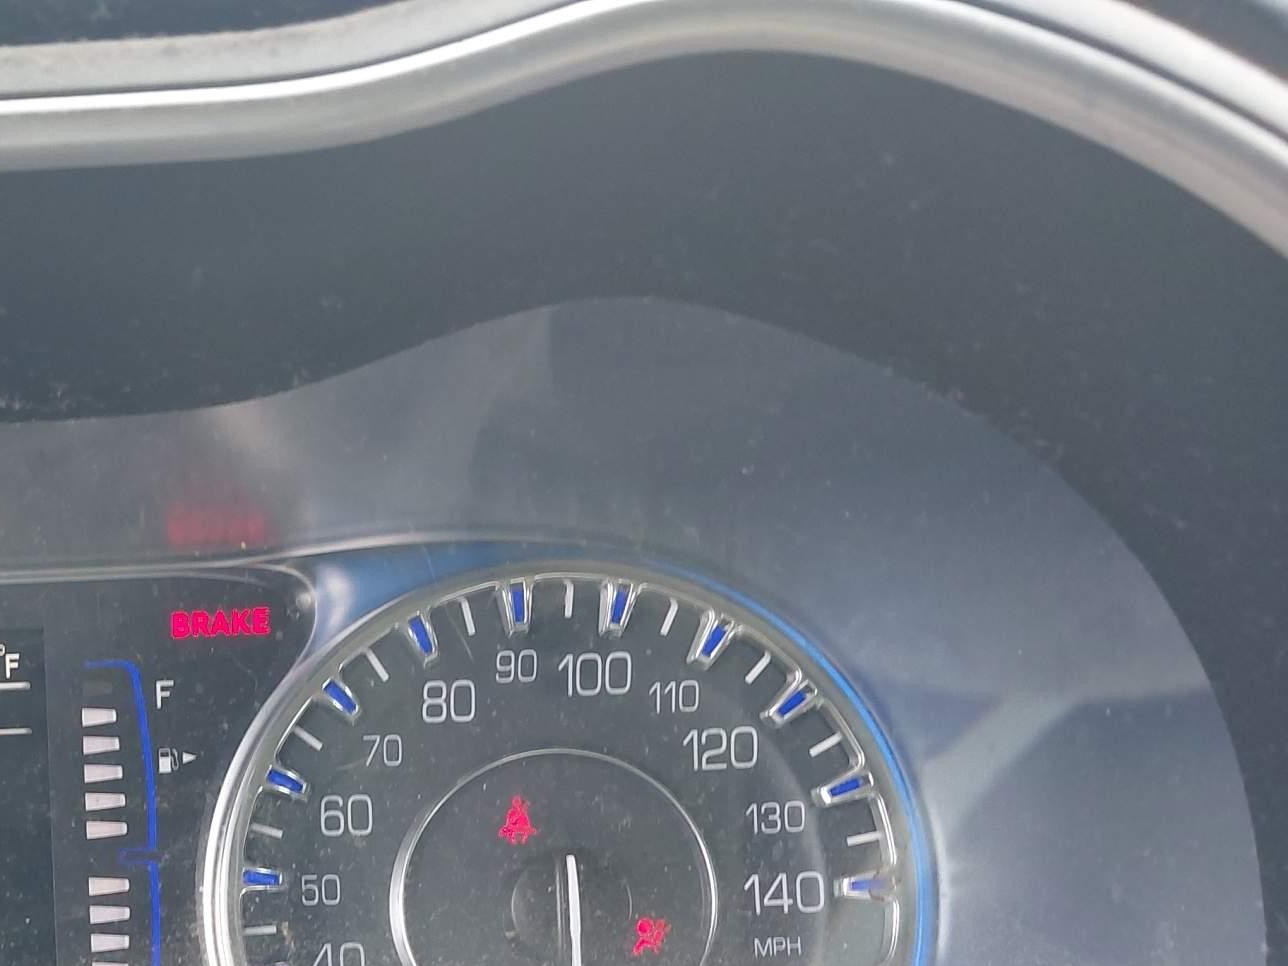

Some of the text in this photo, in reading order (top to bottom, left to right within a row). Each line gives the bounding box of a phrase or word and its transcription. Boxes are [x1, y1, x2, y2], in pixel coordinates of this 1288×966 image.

[171, 607, 270, 639] BRAKE
[495, 650, 537, 683] 90
[558, 652, 632, 696] 100
[155, 680, 174, 708] F
[422, 680, 476, 723] 80
[648, 681, 700, 713] 110
[363, 735, 403, 767] 70
[683, 727, 759, 770] 120
[320, 796, 373, 837] 60
[745, 802, 805, 834] 130
[300, 875, 341, 906] 50
[743, 872, 825, 914] 140
[754, 937, 802, 957] MPH
